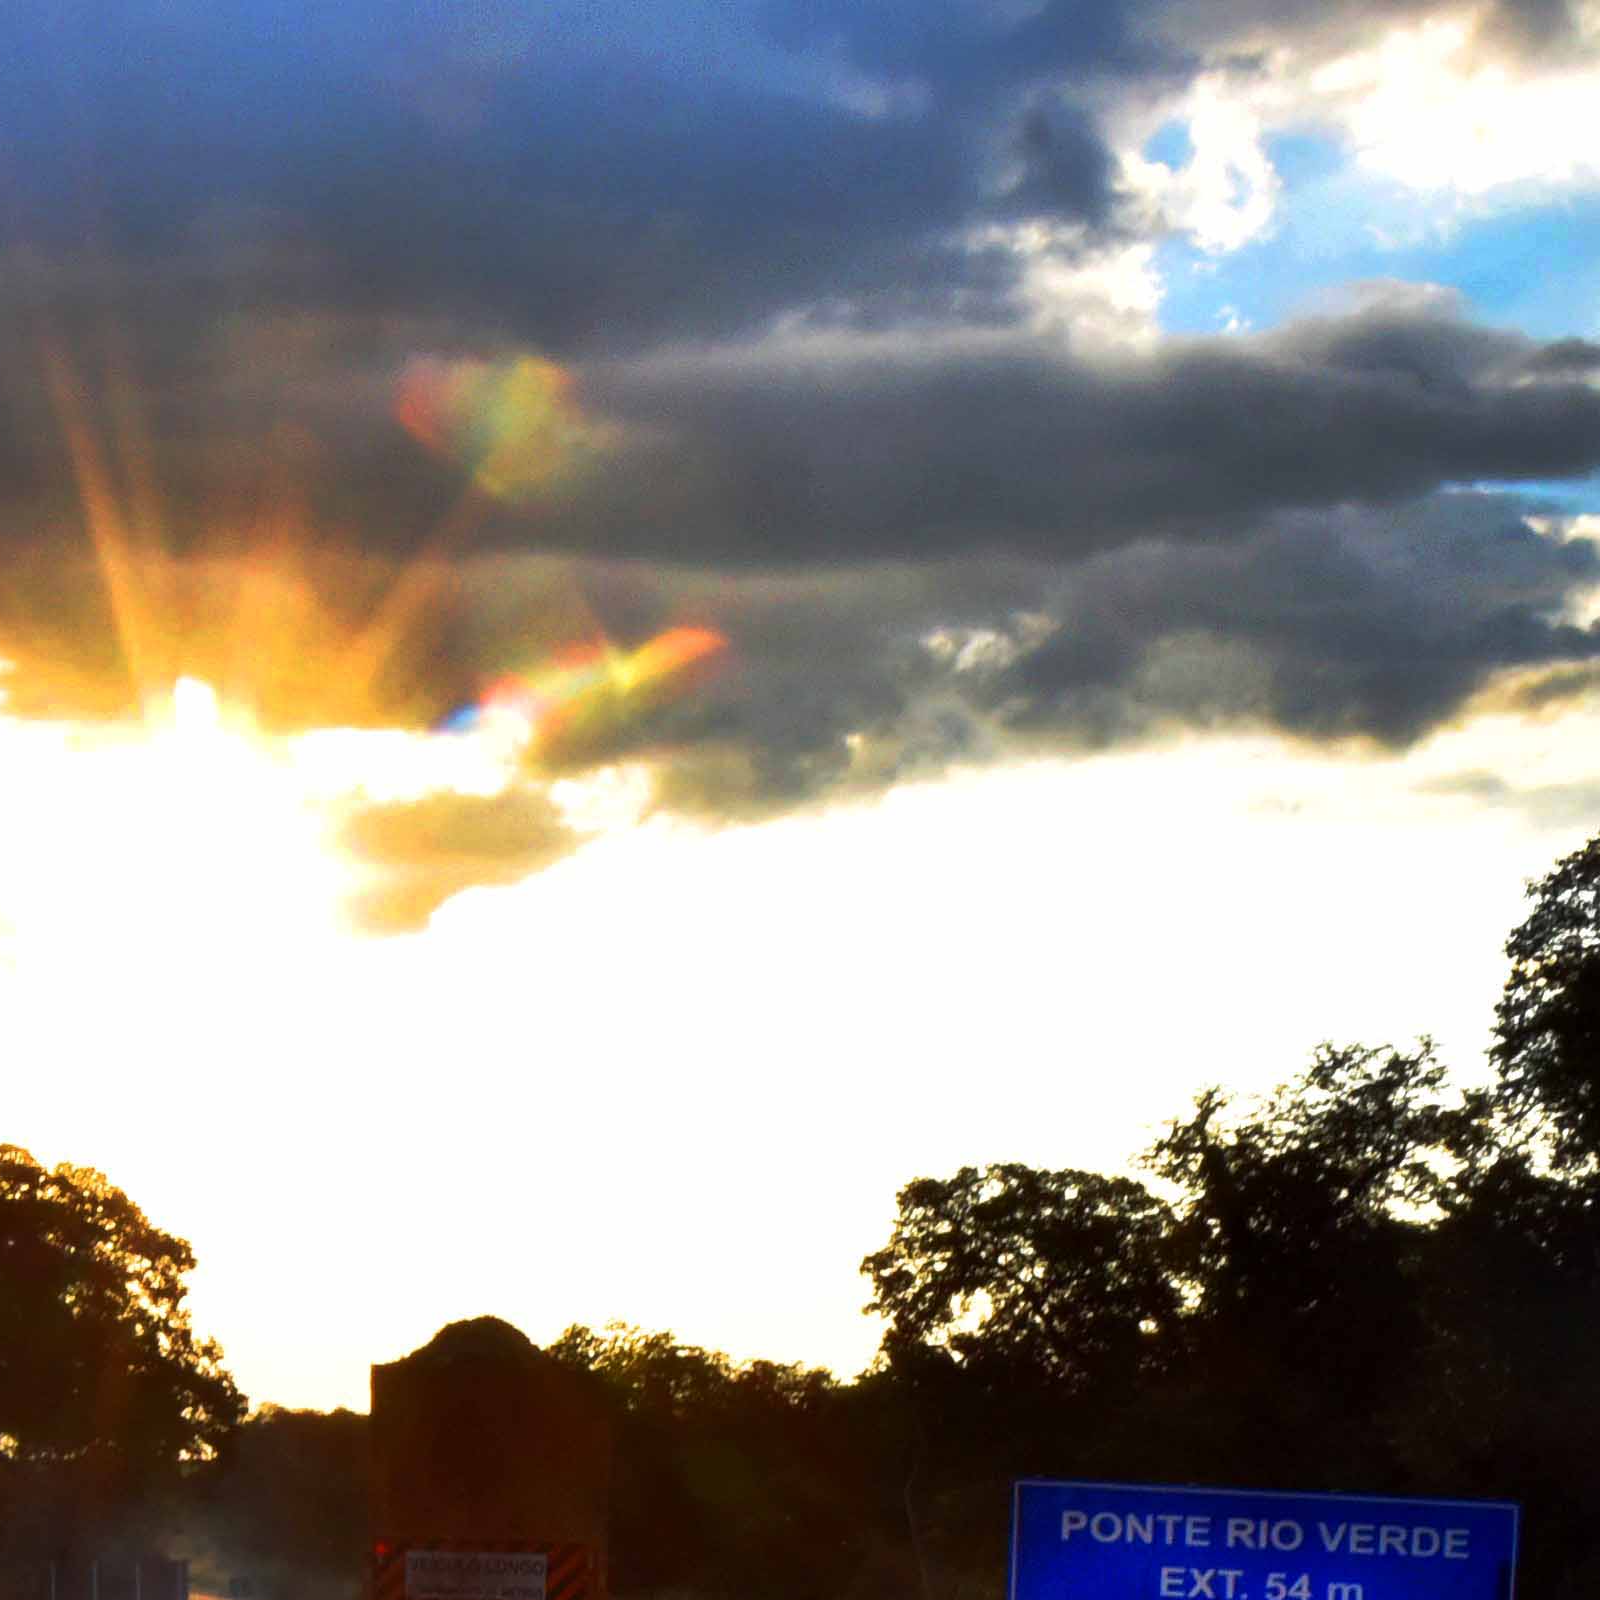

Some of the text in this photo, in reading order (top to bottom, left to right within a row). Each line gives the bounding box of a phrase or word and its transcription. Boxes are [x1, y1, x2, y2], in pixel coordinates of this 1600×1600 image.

[1061, 1510, 1469, 1559] PONTE RIO VERDE
[1159, 1565, 1248, 1600] EXT.
